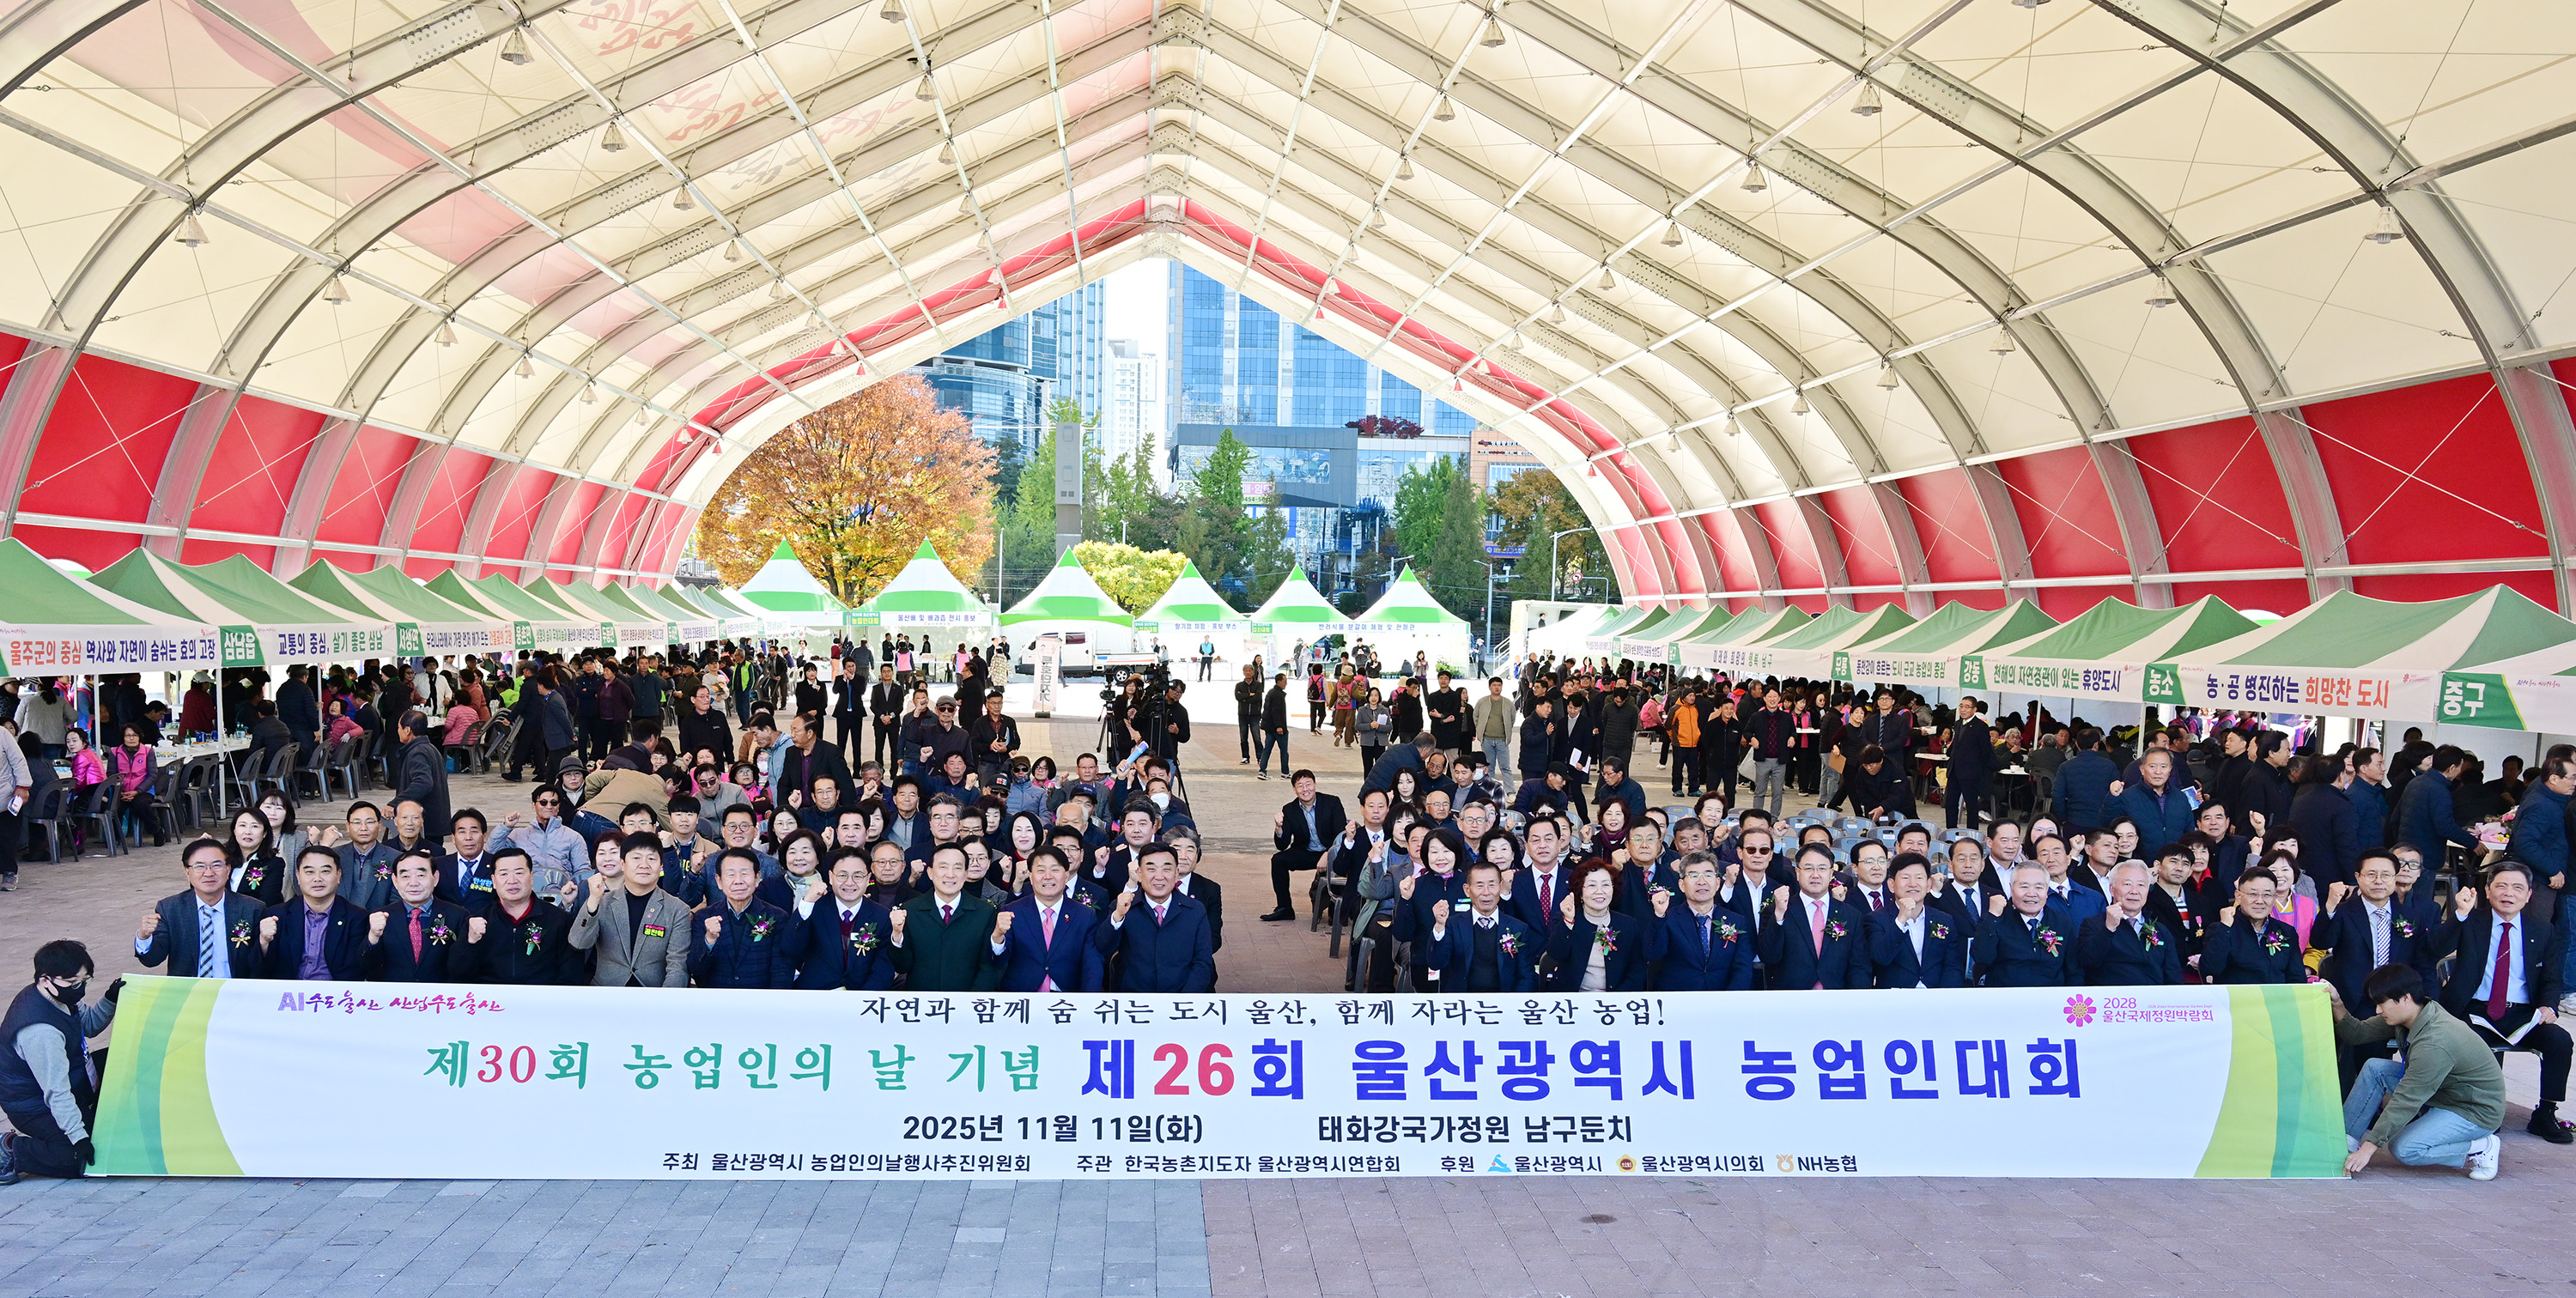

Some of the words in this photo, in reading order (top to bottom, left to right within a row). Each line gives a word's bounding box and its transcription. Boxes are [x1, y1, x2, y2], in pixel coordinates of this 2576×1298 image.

[852, 616, 879, 625] 농업인대회
[278, 634, 306, 655] 교통의
[310, 633, 330, 655] 중심,
[332, 632, 348, 653] 살기
[351, 631, 366, 652] 좋은
[368, 630, 383, 651] 삼남
[398, 628, 419, 651] 서생면
[427, 632, 453, 648] 우리나라에서
[453, 632, 461, 647] 가장
[463, 631, 471, 647] 먼저
[481, 631, 489, 646] 뜨는
[505, 630, 513, 645] 고장
[516, 626, 532, 645] 웅촌면
[10, 640, 57, 666] 울주군의
[60, 640, 82, 665] 중심
[85, 639, 117, 664] 역사와
[118, 639, 148, 663] 자연이
[150, 638, 178, 662] 숨쉬는
[180, 638, 197, 661] 효의
[199, 638, 216, 660] 고장
[224, 632, 256, 660] 삼남읍
[1762, 653, 1772, 669] 남구
[1835, 657, 1848, 676] 무룡
[1856, 659, 1875, 676] 동천강이
[1876, 660, 1891, 676] 흐르는
[1893, 661, 1903, 676] 도시
[1904, 661, 1914, 677] 근교
[1916, 661, 1932, 678] 농업의
[1934, 662, 1946, 679] 중심
[1964, 660, 1980, 683] 강동
[1994, 664, 2016, 685] 천해의
[2018, 665, 2059, 688] 자연경관이
[2062, 668, 2079, 690] 있는
[2082, 669, 2121, 692] 휴양도시
[2149, 670, 2174, 696] 농소
[2245, 675, 2300, 704] 병진하는
[2306, 676, 2351, 707] 희망찬
[2357, 679, 2390, 708] 도시
[2444, 681, 2486, 717] 중구
[860, 997, 954, 1024] 자연과
[971, 998, 1030, 1024] 함께
[1048, 998, 1077, 1024] 숨
[1094, 999, 1154, 1025] 쉬는
[1170, 999, 1226, 1025] 도시
[1245, 999, 1316, 1027] 울산,
[1335, 999, 1394, 1026] 함께
[1412, 999, 1503, 1026] 자라는
[1517, 999, 1578, 1025] 울산
[1593, 998, 1664, 1026] 농업!
[2104, 998, 2137, 1009] 2028
[2103, 1010, 2213, 1022] 울산국제정원박람회
[423, 1040, 589, 1089] 제30회
[623, 1043, 831, 1091] 농업인의
[868, 1044, 915, 1090] 날
[946, 1045, 1039, 1092] 기념
[1082, 1038, 1303, 1100] 제26회
[1352, 1040, 1694, 1101] 울산광역시
[1741, 1038, 2081, 1101] 농업인대회
[903, 1115, 1003, 1142] 2025년
[1018, 1115, 1077, 1142] 11월
[1092, 1114, 1202, 1143] 11일(화)
[1319, 1115, 1510, 1143] 태화강국가정원
[1525, 1115, 1631, 1143] 남구둔치
[663, 1153, 698, 1170] 주최
[712, 1153, 803, 1171] 울산광역시
[811, 1154, 1030, 1172] 농업인의날행사추진위원회
[1077, 1155, 1112, 1172] 주관
[1125, 1155, 1252, 1173] 한국농촌지도자
[1258, 1155, 1400, 1172] 울산광역시연합회
[1441, 1155, 1474, 1172] 후원
[1515, 1156, 1601, 1172] 울산광역시
[1642, 1155, 1765, 1172] 울산광역시의회
[1797, 1155, 1857, 1172] NH농협
